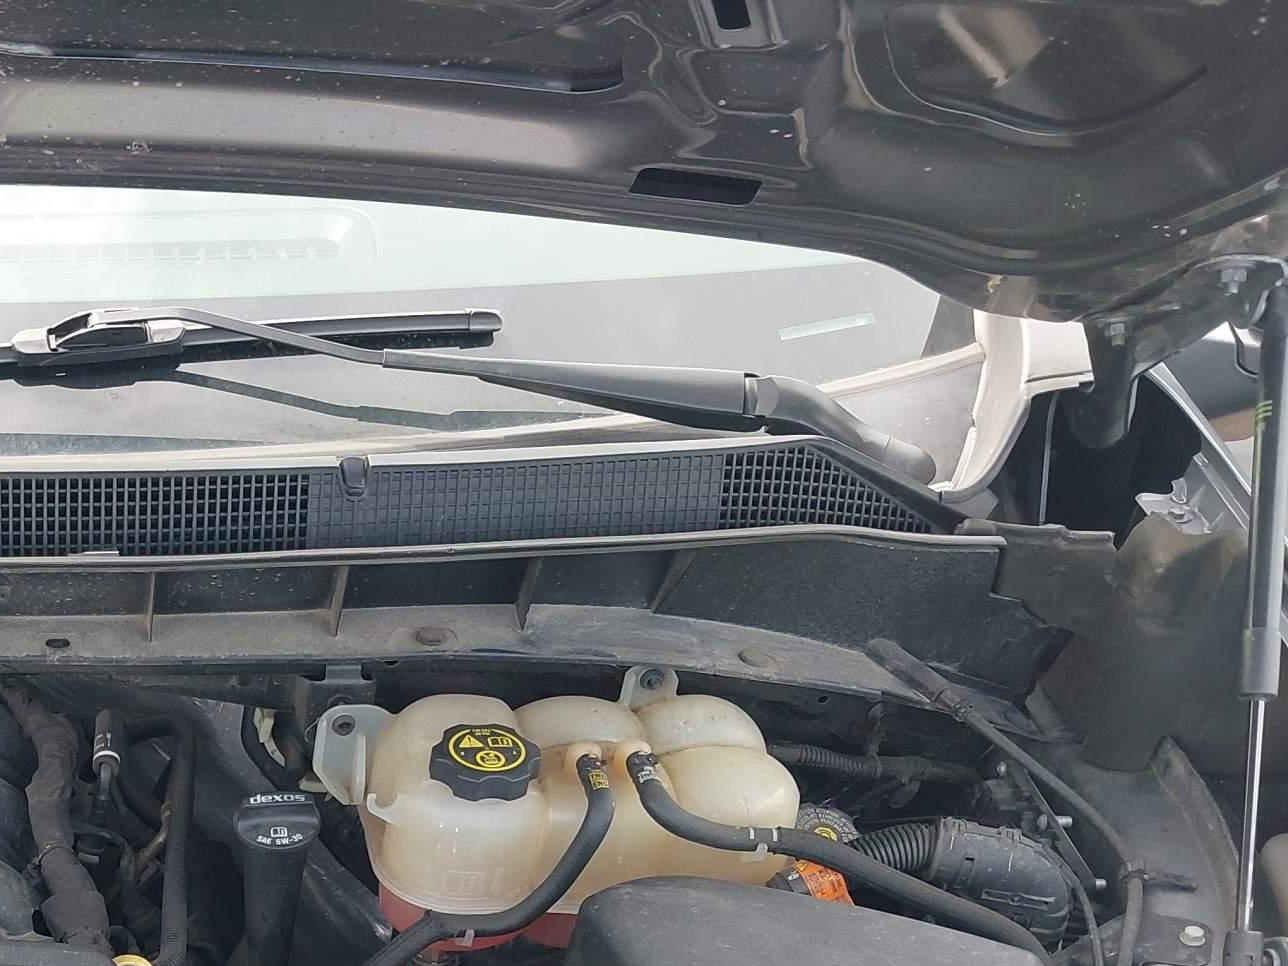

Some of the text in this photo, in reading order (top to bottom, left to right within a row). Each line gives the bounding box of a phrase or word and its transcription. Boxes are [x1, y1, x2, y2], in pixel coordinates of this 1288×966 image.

[249, 793, 306, 804] dexos
[255, 833, 303, 845] SAE 5W-30
